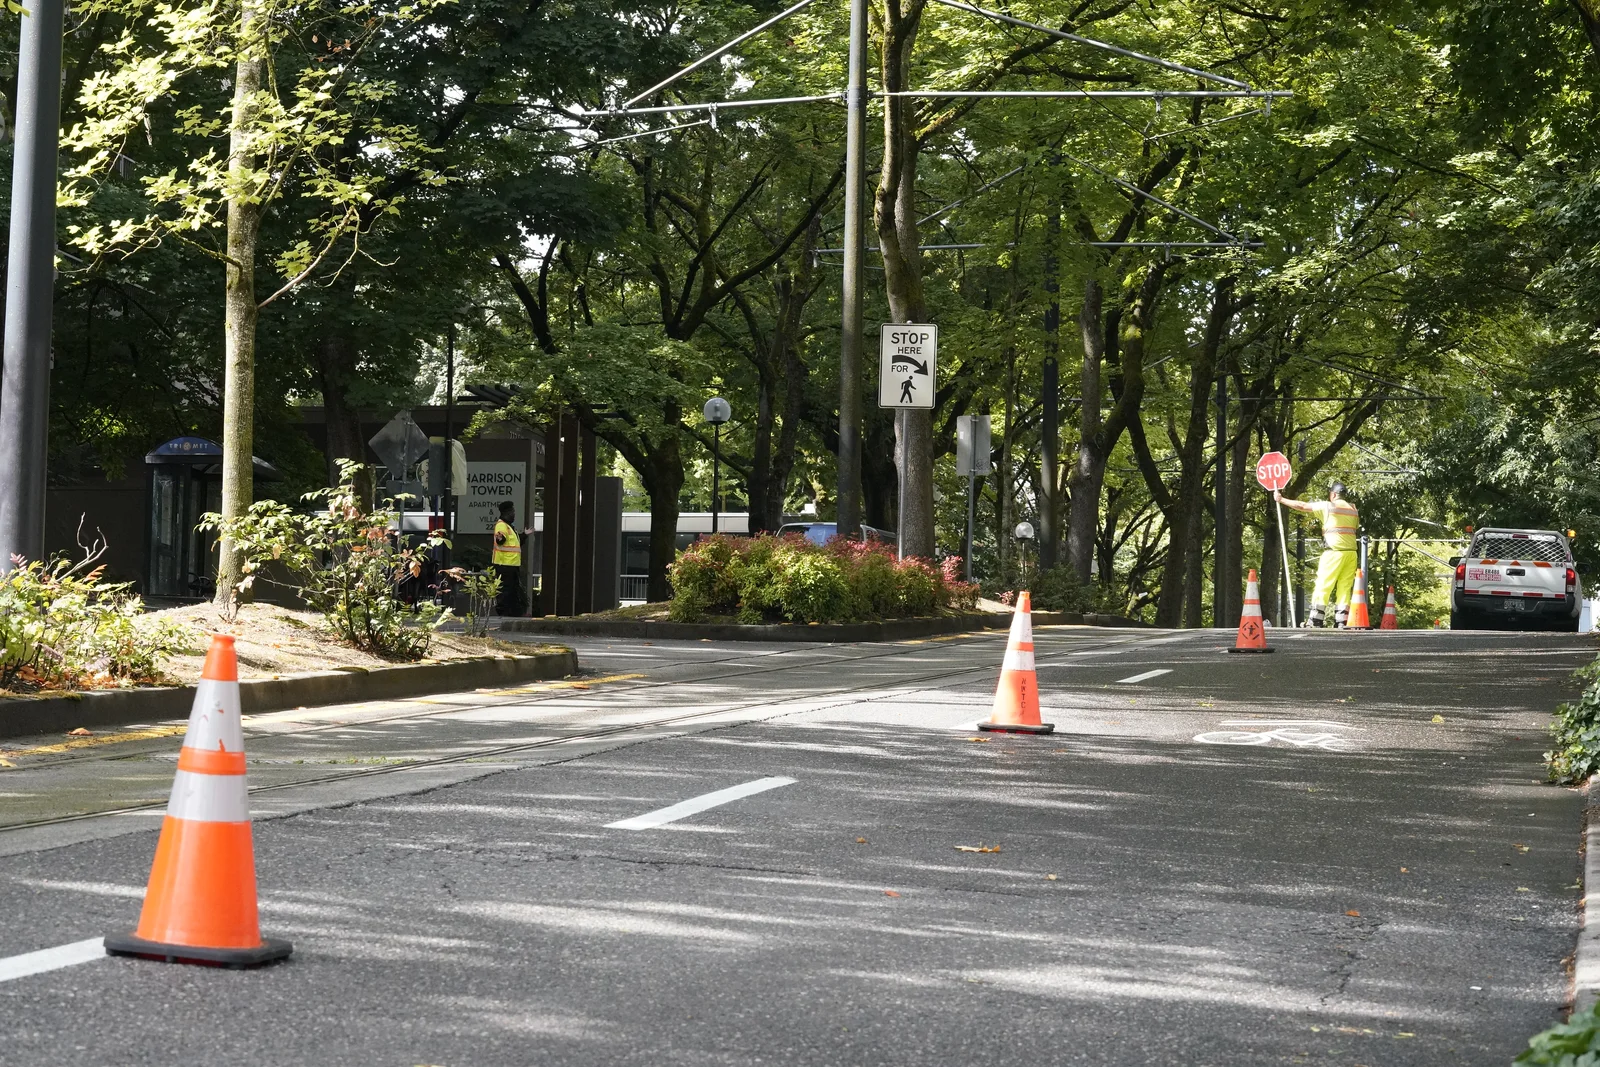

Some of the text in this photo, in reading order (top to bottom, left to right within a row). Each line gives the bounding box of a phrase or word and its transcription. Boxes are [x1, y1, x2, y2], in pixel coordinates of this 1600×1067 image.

[891, 332, 929, 345] STOP
[897, 346, 922, 355] HERE
[891, 365, 909, 373] FOR
[1258, 463, 1289, 480] STOP
[471, 485, 513, 496] TOWER
[489, 508, 494, 516] &
